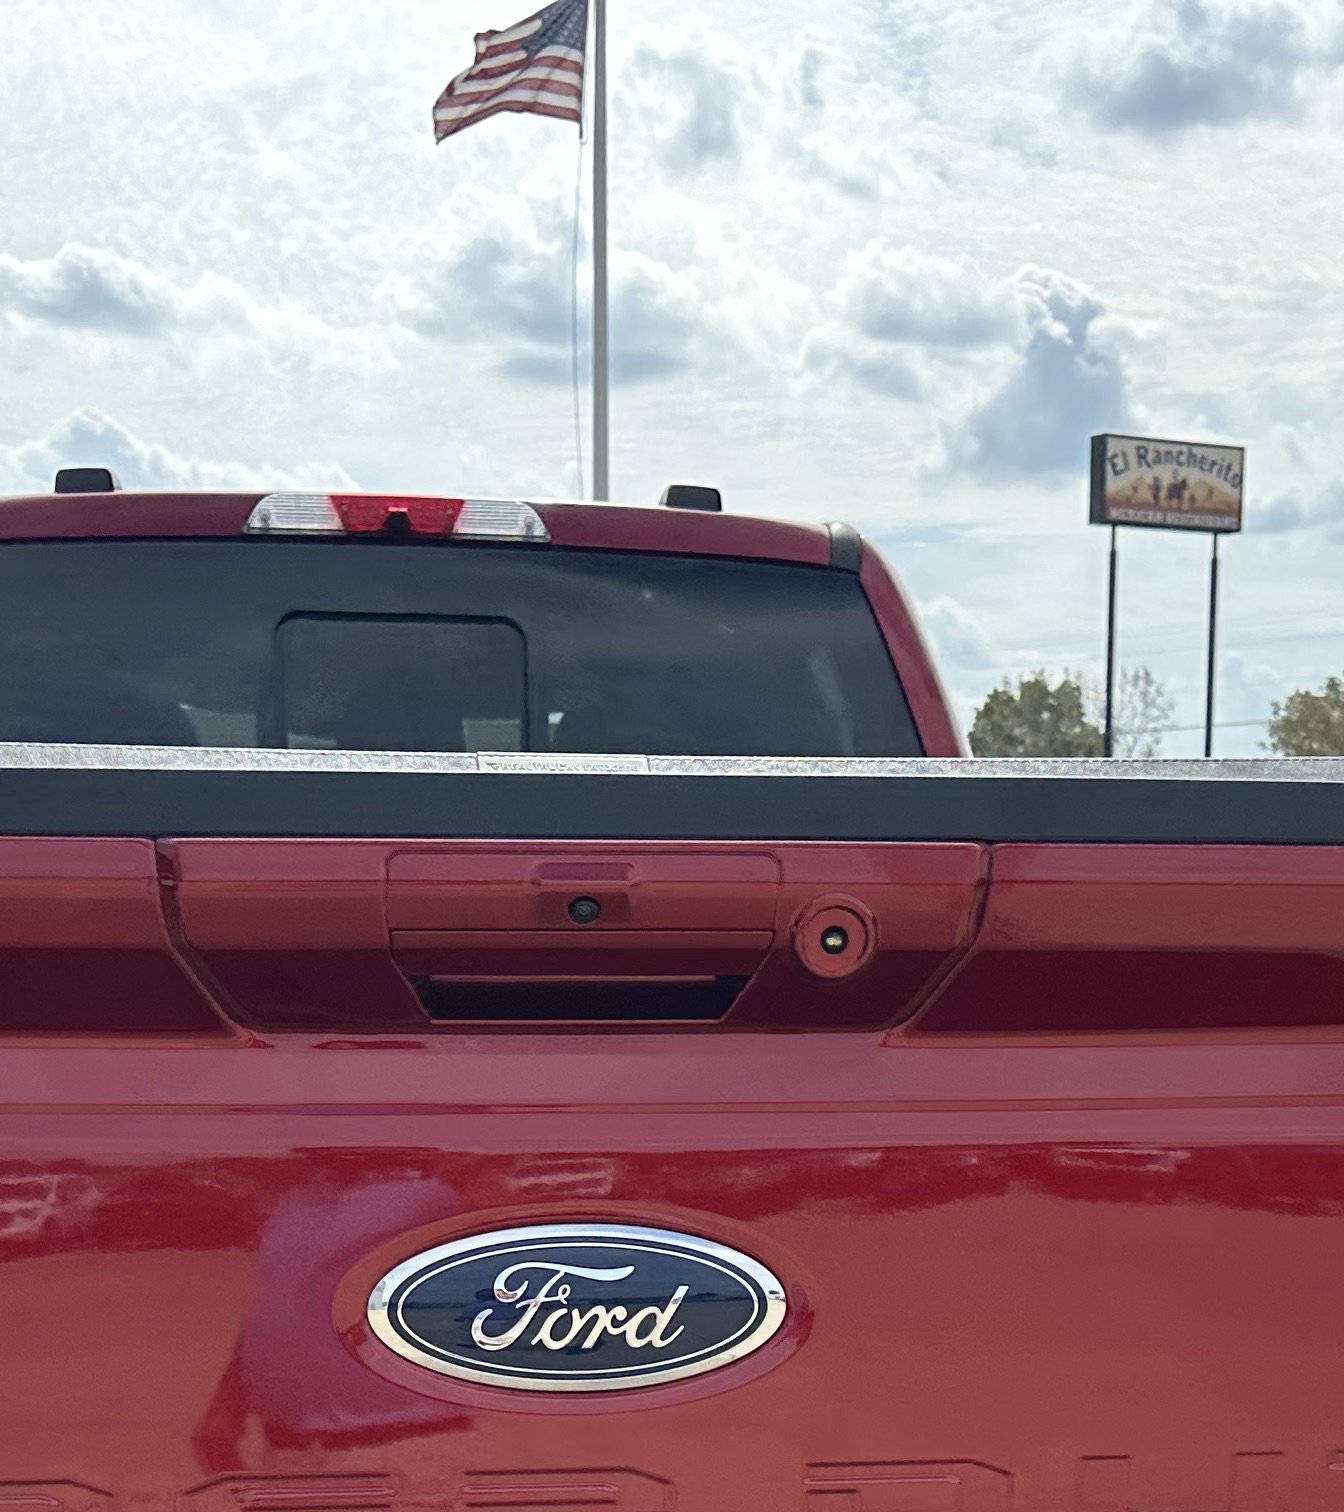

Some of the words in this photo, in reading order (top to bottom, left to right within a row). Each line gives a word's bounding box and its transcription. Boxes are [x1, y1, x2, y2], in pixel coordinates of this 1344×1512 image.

[1107, 451, 1130, 477] El
[1135, 445, 1241, 489] Rancherito
[471, 1261, 690, 1352] Ford
